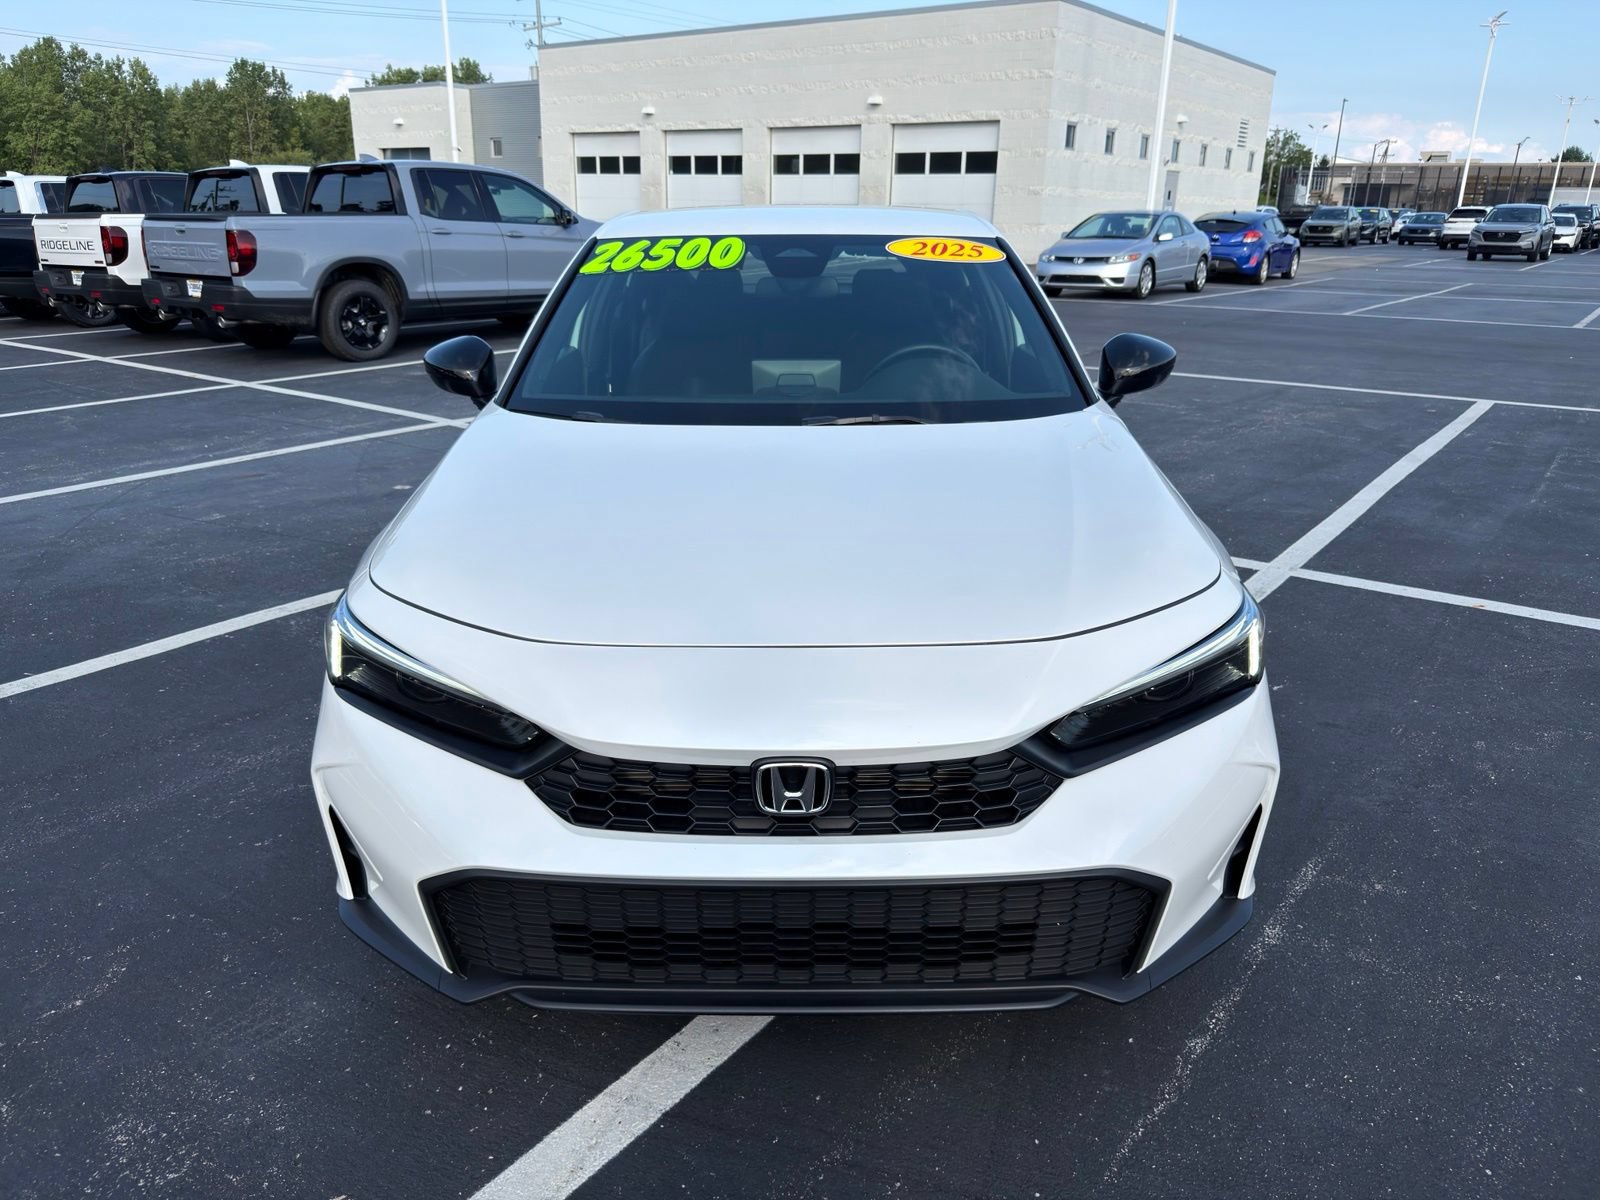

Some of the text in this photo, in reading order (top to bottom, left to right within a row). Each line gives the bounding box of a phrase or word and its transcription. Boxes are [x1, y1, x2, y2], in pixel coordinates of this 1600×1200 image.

[40, 239, 95, 251] RIDGELINE
[911, 242, 984, 257] 2025
[579, 237, 745, 274] 26500
